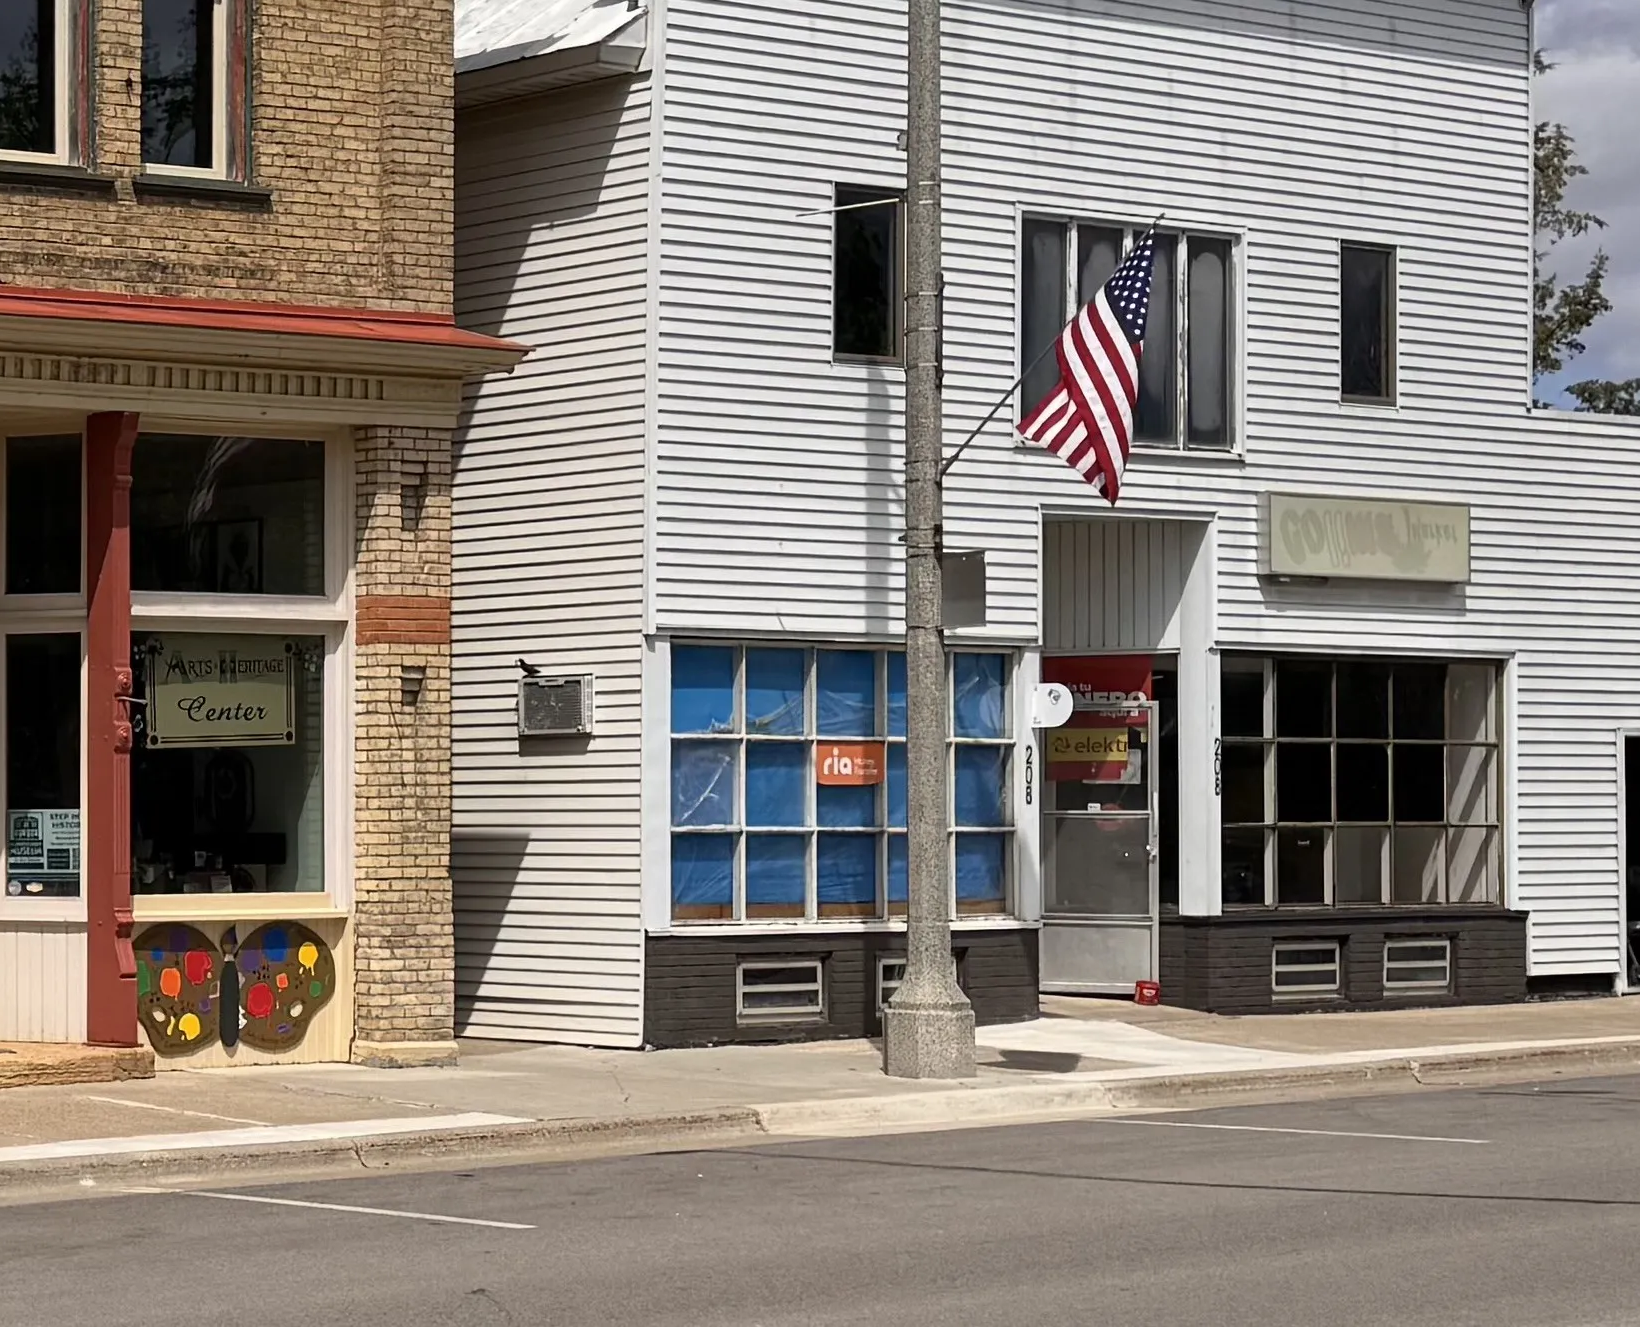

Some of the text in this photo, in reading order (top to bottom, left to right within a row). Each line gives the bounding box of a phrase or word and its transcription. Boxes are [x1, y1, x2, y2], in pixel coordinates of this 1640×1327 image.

[177, 696, 269, 723] Center
[823, 746, 853, 775] ria
[1025, 744, 1033, 805] 208
[1214, 737, 1222, 796] 208
